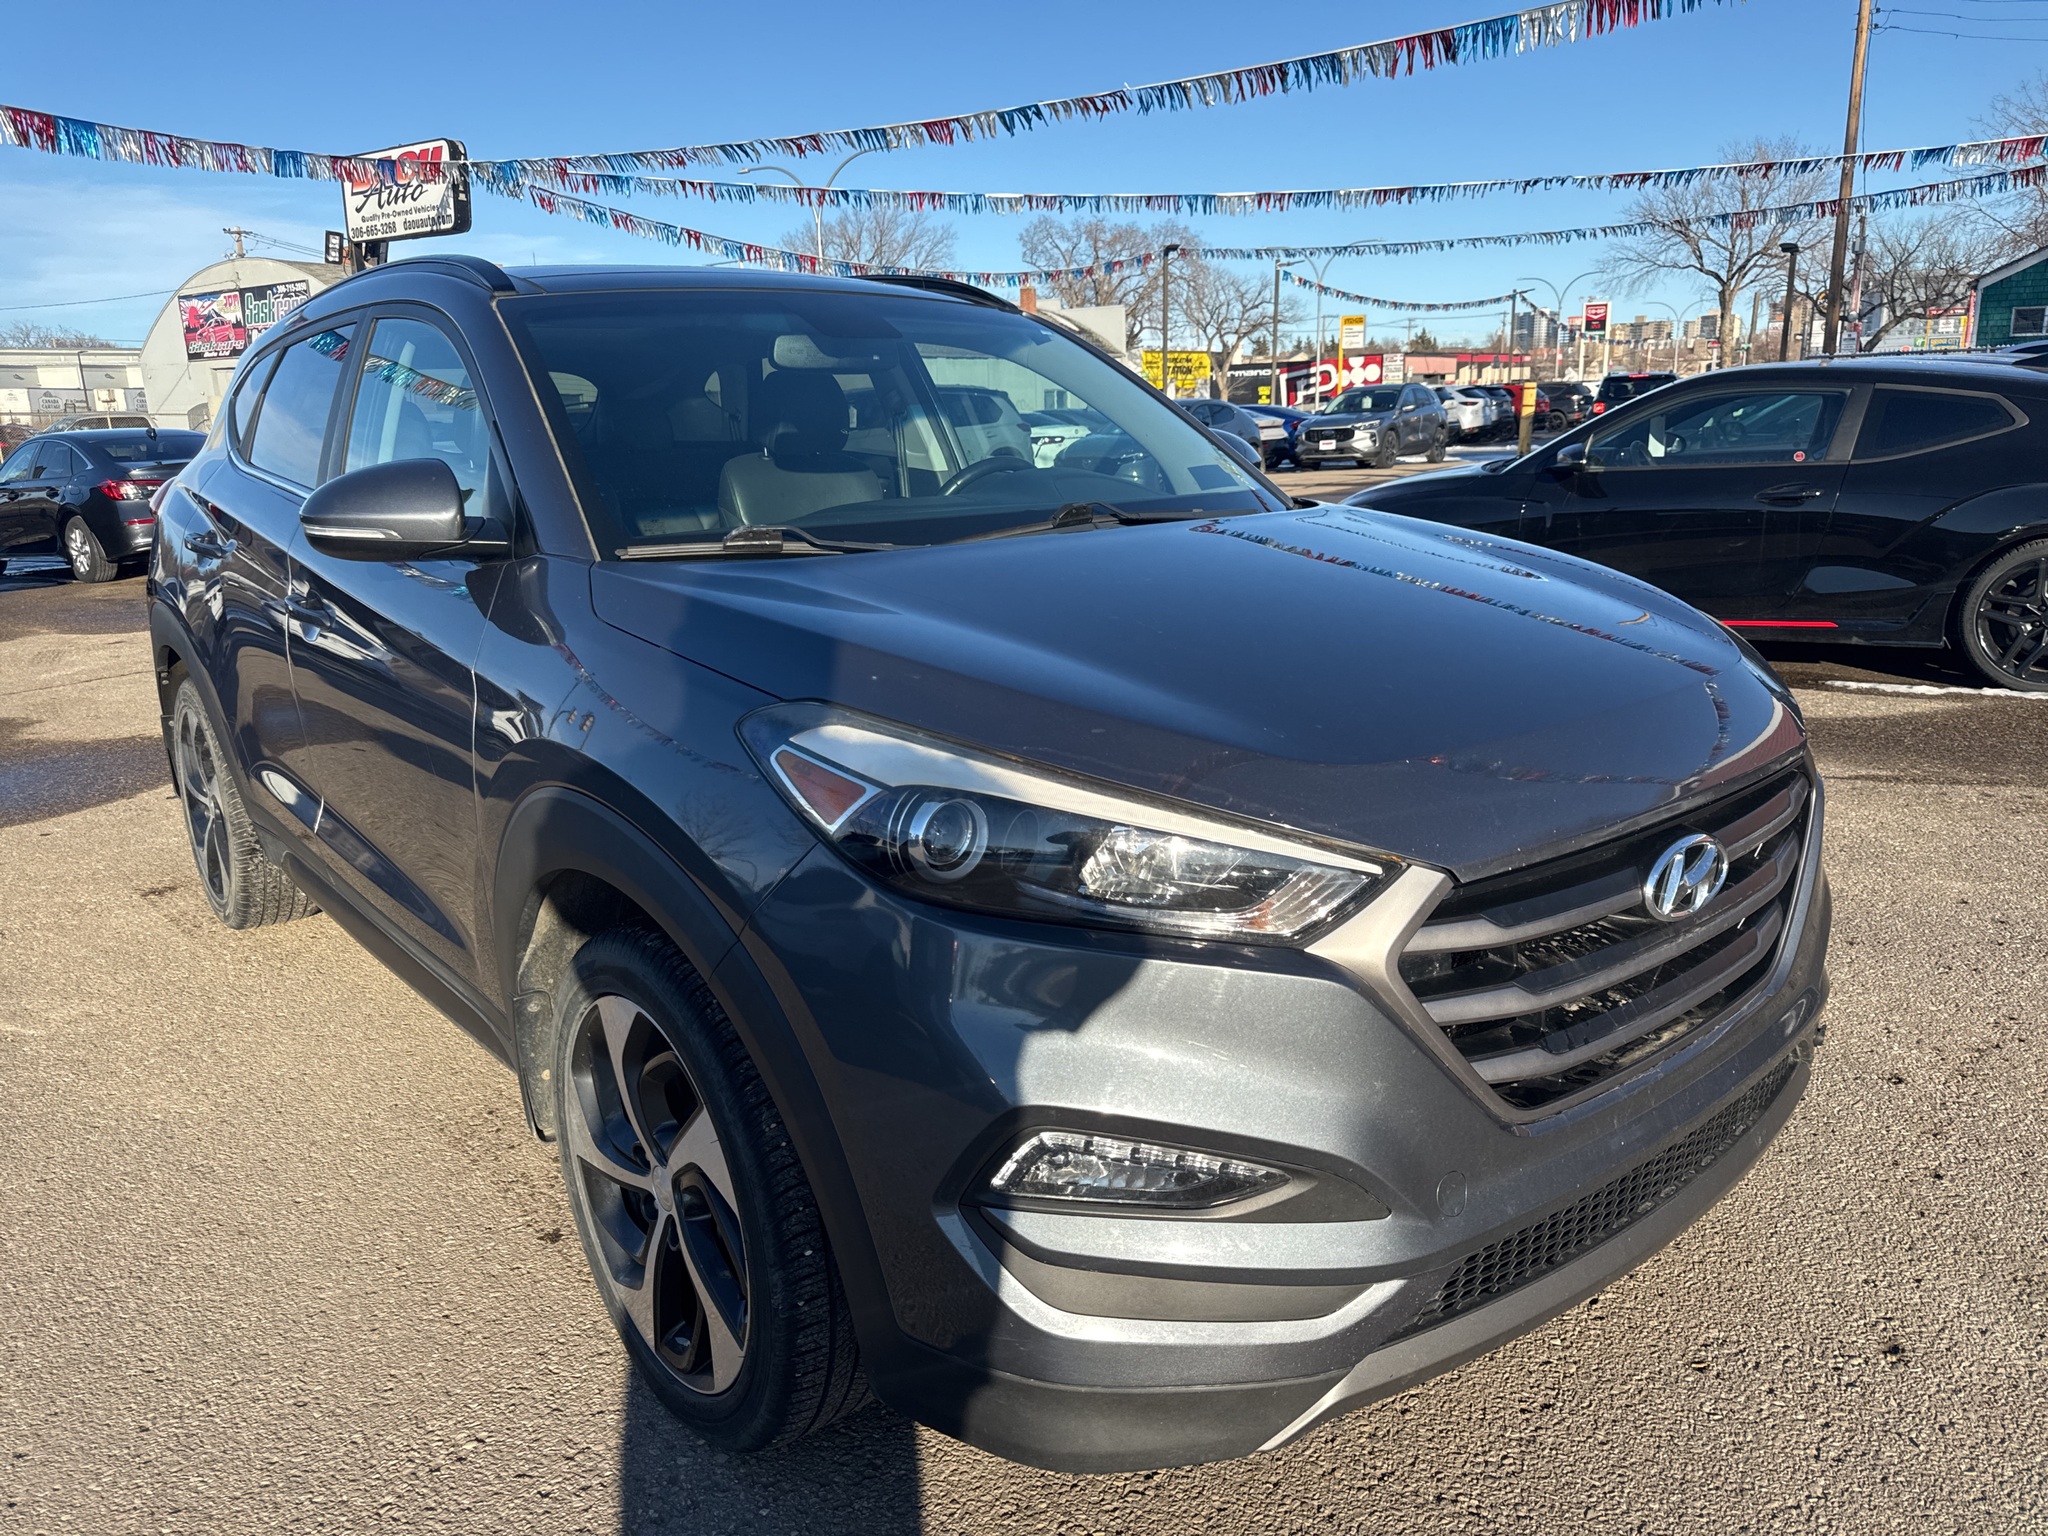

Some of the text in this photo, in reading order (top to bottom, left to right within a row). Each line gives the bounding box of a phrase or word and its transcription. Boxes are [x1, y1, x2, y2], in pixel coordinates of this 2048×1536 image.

[355, 182, 428, 213] Auto
[361, 204, 440, 223] Quality Pre-Owned Vehicles
[351, 213, 453, 239] 306-665-3268 daouauto.com
[188, 339, 245, 354] Saskcars
[1167, 365, 1193, 375] TATION
